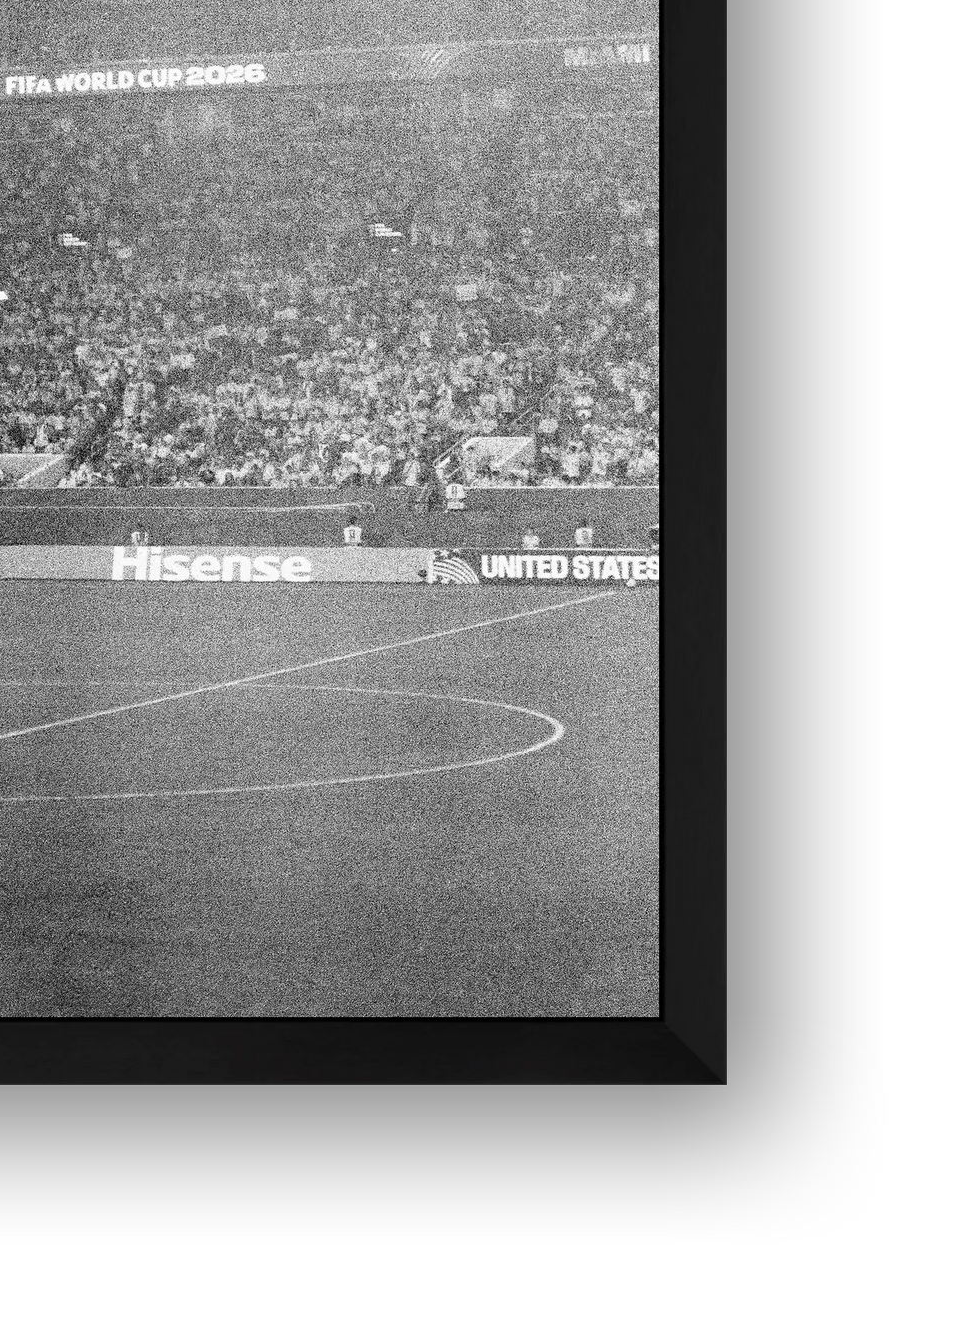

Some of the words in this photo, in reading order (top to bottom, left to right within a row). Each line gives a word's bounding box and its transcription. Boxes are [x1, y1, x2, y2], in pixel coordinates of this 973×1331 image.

[5, 75, 52, 95] FIFA
[55, 70, 134, 92] WORLD
[137, 67, 182, 88] CUP
[185, 64, 267, 85] 2026
[111, 545, 312, 582] Hisense
[481, 555, 569, 579] UNITED
[572, 555, 659, 580] STATES
